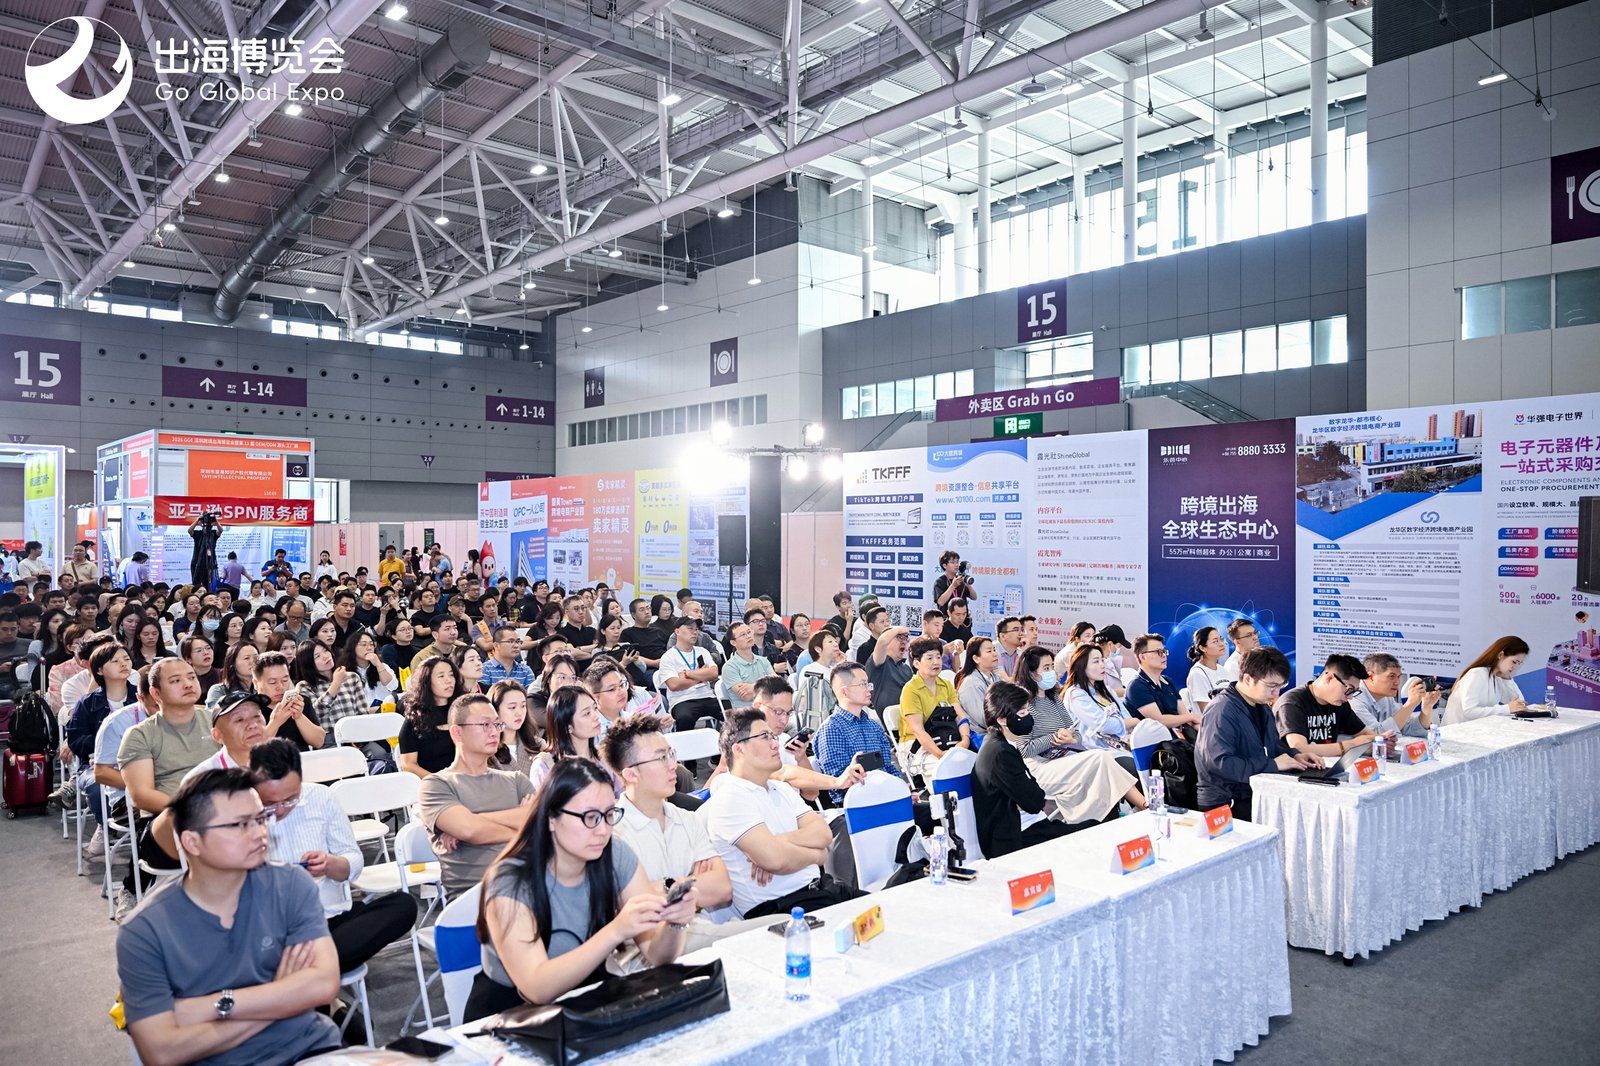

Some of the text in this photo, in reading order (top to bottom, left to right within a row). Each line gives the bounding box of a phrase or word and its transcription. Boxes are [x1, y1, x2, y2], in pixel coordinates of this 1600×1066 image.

[1027, 291, 1057, 328] 15
[14, 350, 62, 387] 15
[242, 381, 274, 397] 1-14
[968, 390, 1074, 414] 外卖区 Grab n Go
[522, 405, 545, 418] 1-14
[1526, 412, 1583, 423] 华强电子世界
[1312, 421, 1401, 434] 龙华区数字经济跨境电商产业园
[1238, 445, 1260, 456] 8880
[1263, 443, 1286, 454] 3333
[872, 466, 911, 480] TKFFF
[168, 503, 308, 521] 亚马逊SPN服务商
[513, 502, 545, 518] OPC一人公司
[1037, 506, 1062, 514] 内容平台
[1180, 495, 1258, 516] 跨境出海
[593, 518, 630, 533] 卖家精灵
[1162, 519, 1279, 540] 全球生态中心
[1038, 617, 1062, 625] 企业服务
[1308, 712, 1336, 728] HUMAN
